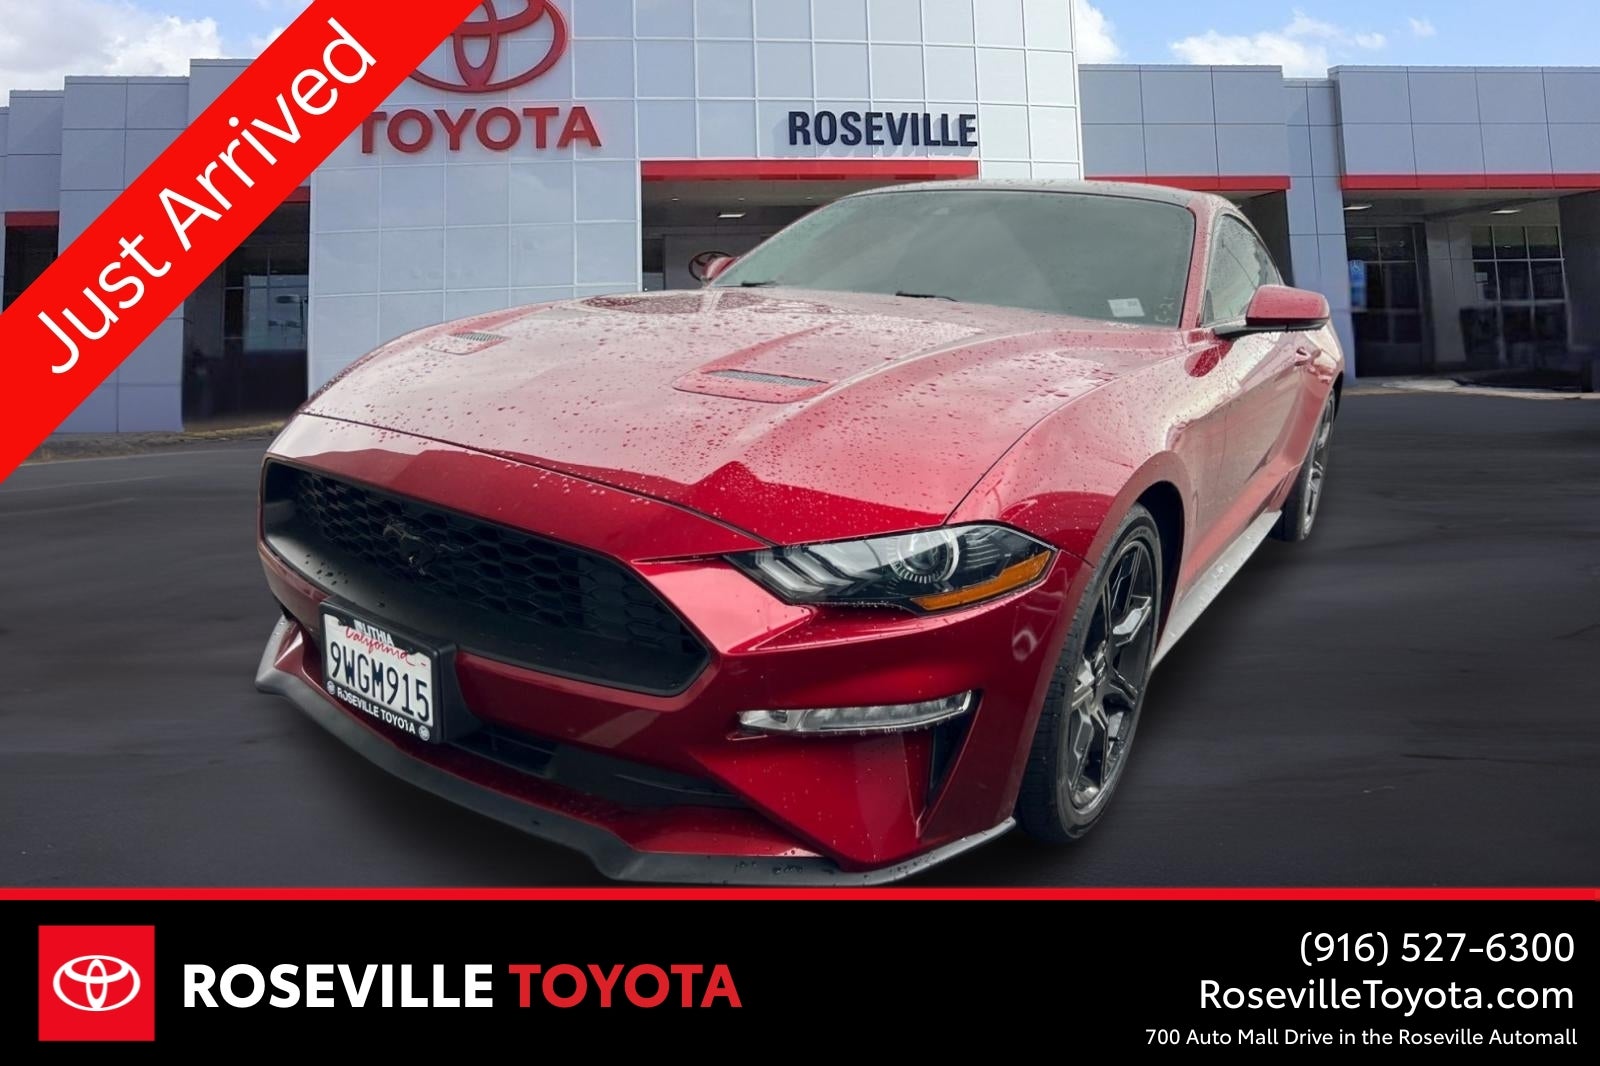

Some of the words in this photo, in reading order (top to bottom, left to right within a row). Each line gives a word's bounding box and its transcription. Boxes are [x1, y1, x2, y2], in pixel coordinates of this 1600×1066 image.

[361, 106, 601, 154] TOYOTA
[788, 110, 978, 147] ROSEVILLE
[330, 641, 430, 723] 9WGM915
[337, 687, 380, 718] ROSEVILLE
[380, 709, 416, 735] TOYOTA
